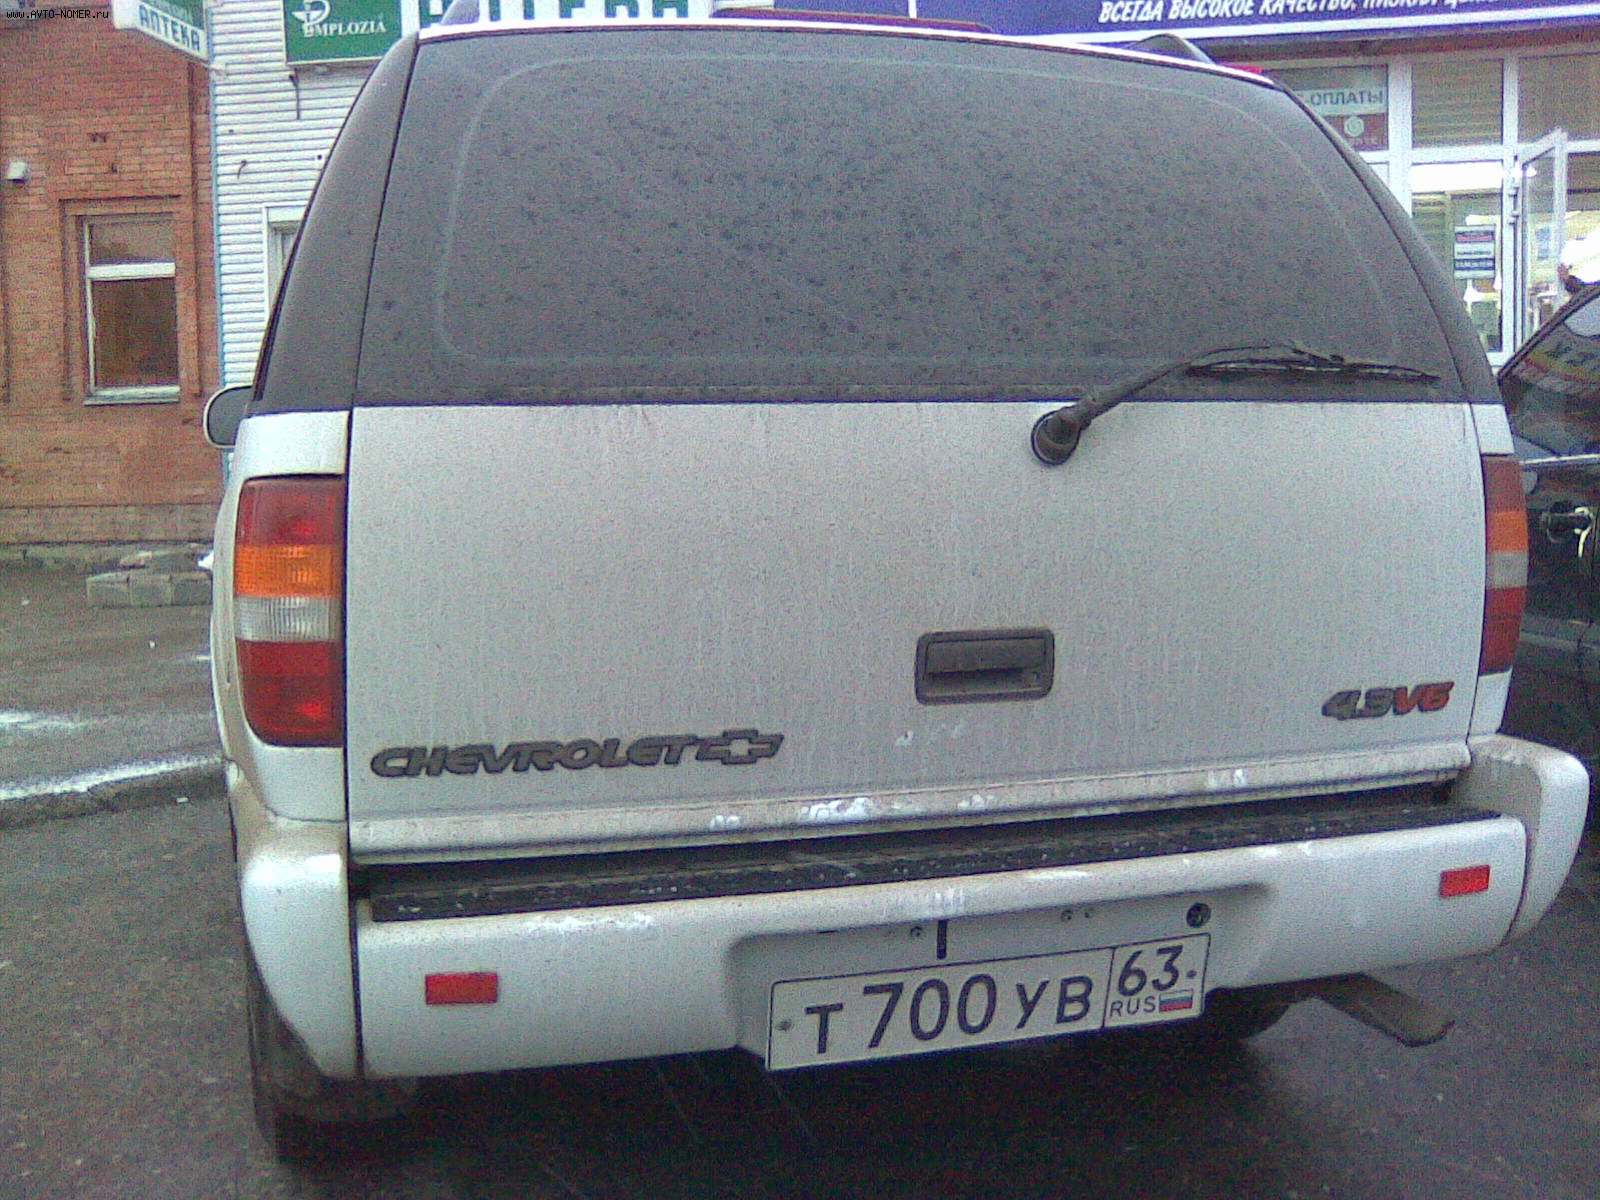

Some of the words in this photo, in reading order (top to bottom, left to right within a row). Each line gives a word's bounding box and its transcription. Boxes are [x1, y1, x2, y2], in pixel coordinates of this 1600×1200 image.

[139, 4, 200, 52] АПТЕКА
[1098, 1, 1164, 23] ВСЕГДА
[1168, 0, 1255, 20] ВЫСОКОЕ
[1310, 89, 1383, 106] ОПЛАТЫ
[370, 734, 700, 777] CHEVROLET
[1117, 945, 1184, 997] 63
[1109, 995, 1156, 1018] RUS
